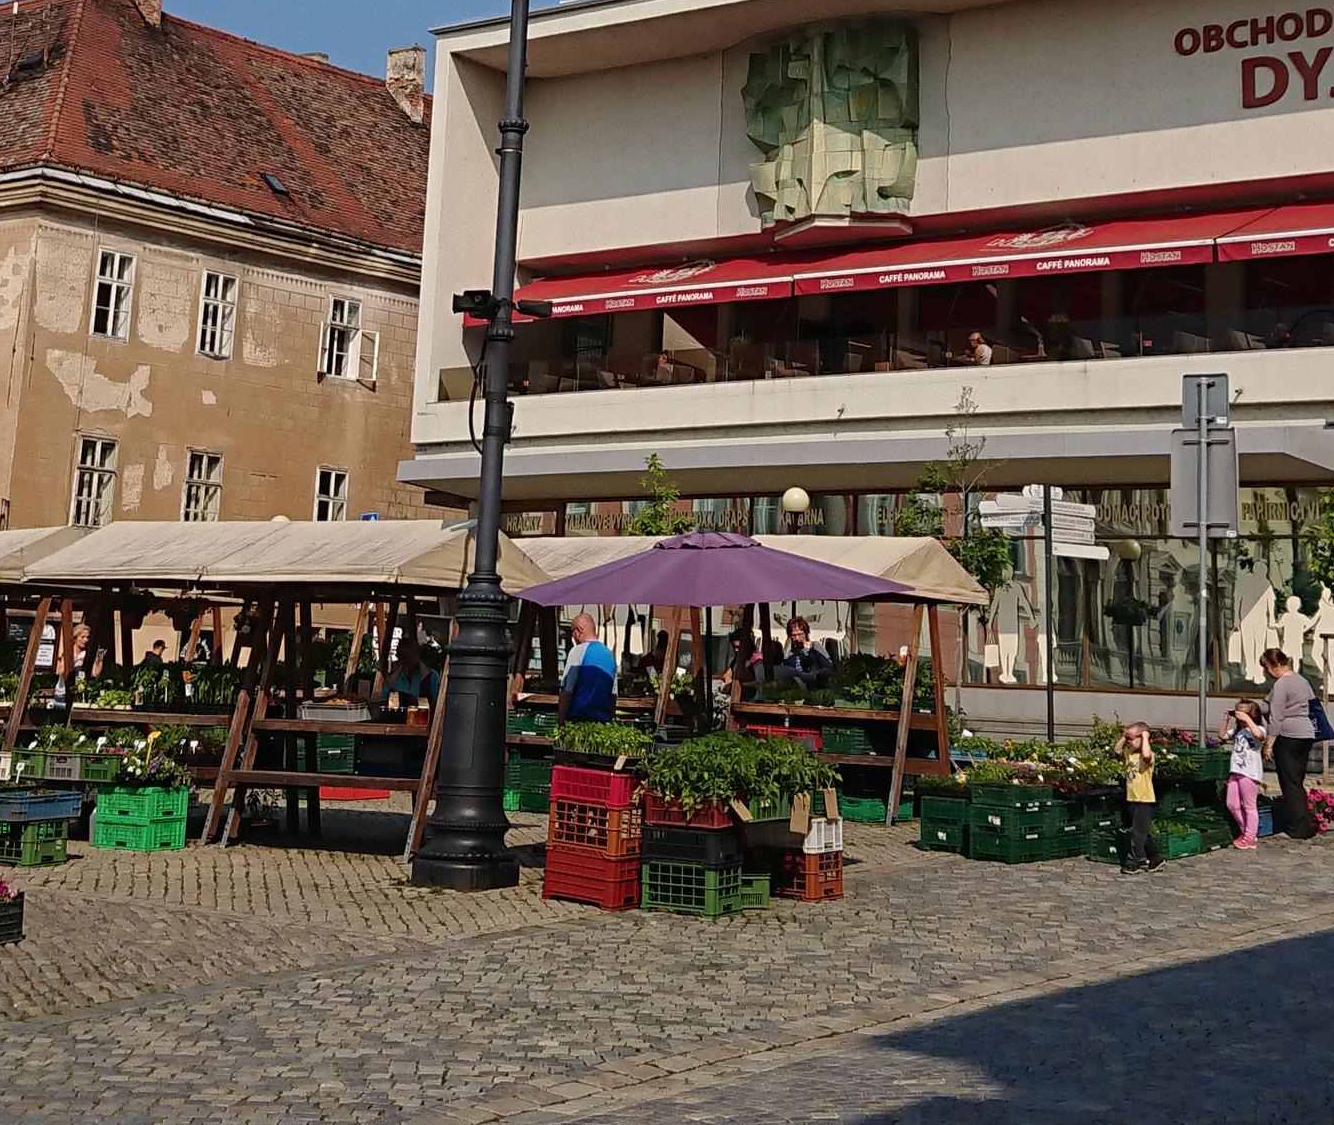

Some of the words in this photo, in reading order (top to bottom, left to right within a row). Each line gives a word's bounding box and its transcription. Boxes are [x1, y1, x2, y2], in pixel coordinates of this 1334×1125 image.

[1064, 256, 1110, 269] PANORAMA
[903, 270, 945, 282] PANORAMA
[677, 291, 713, 302] PANORAMA
